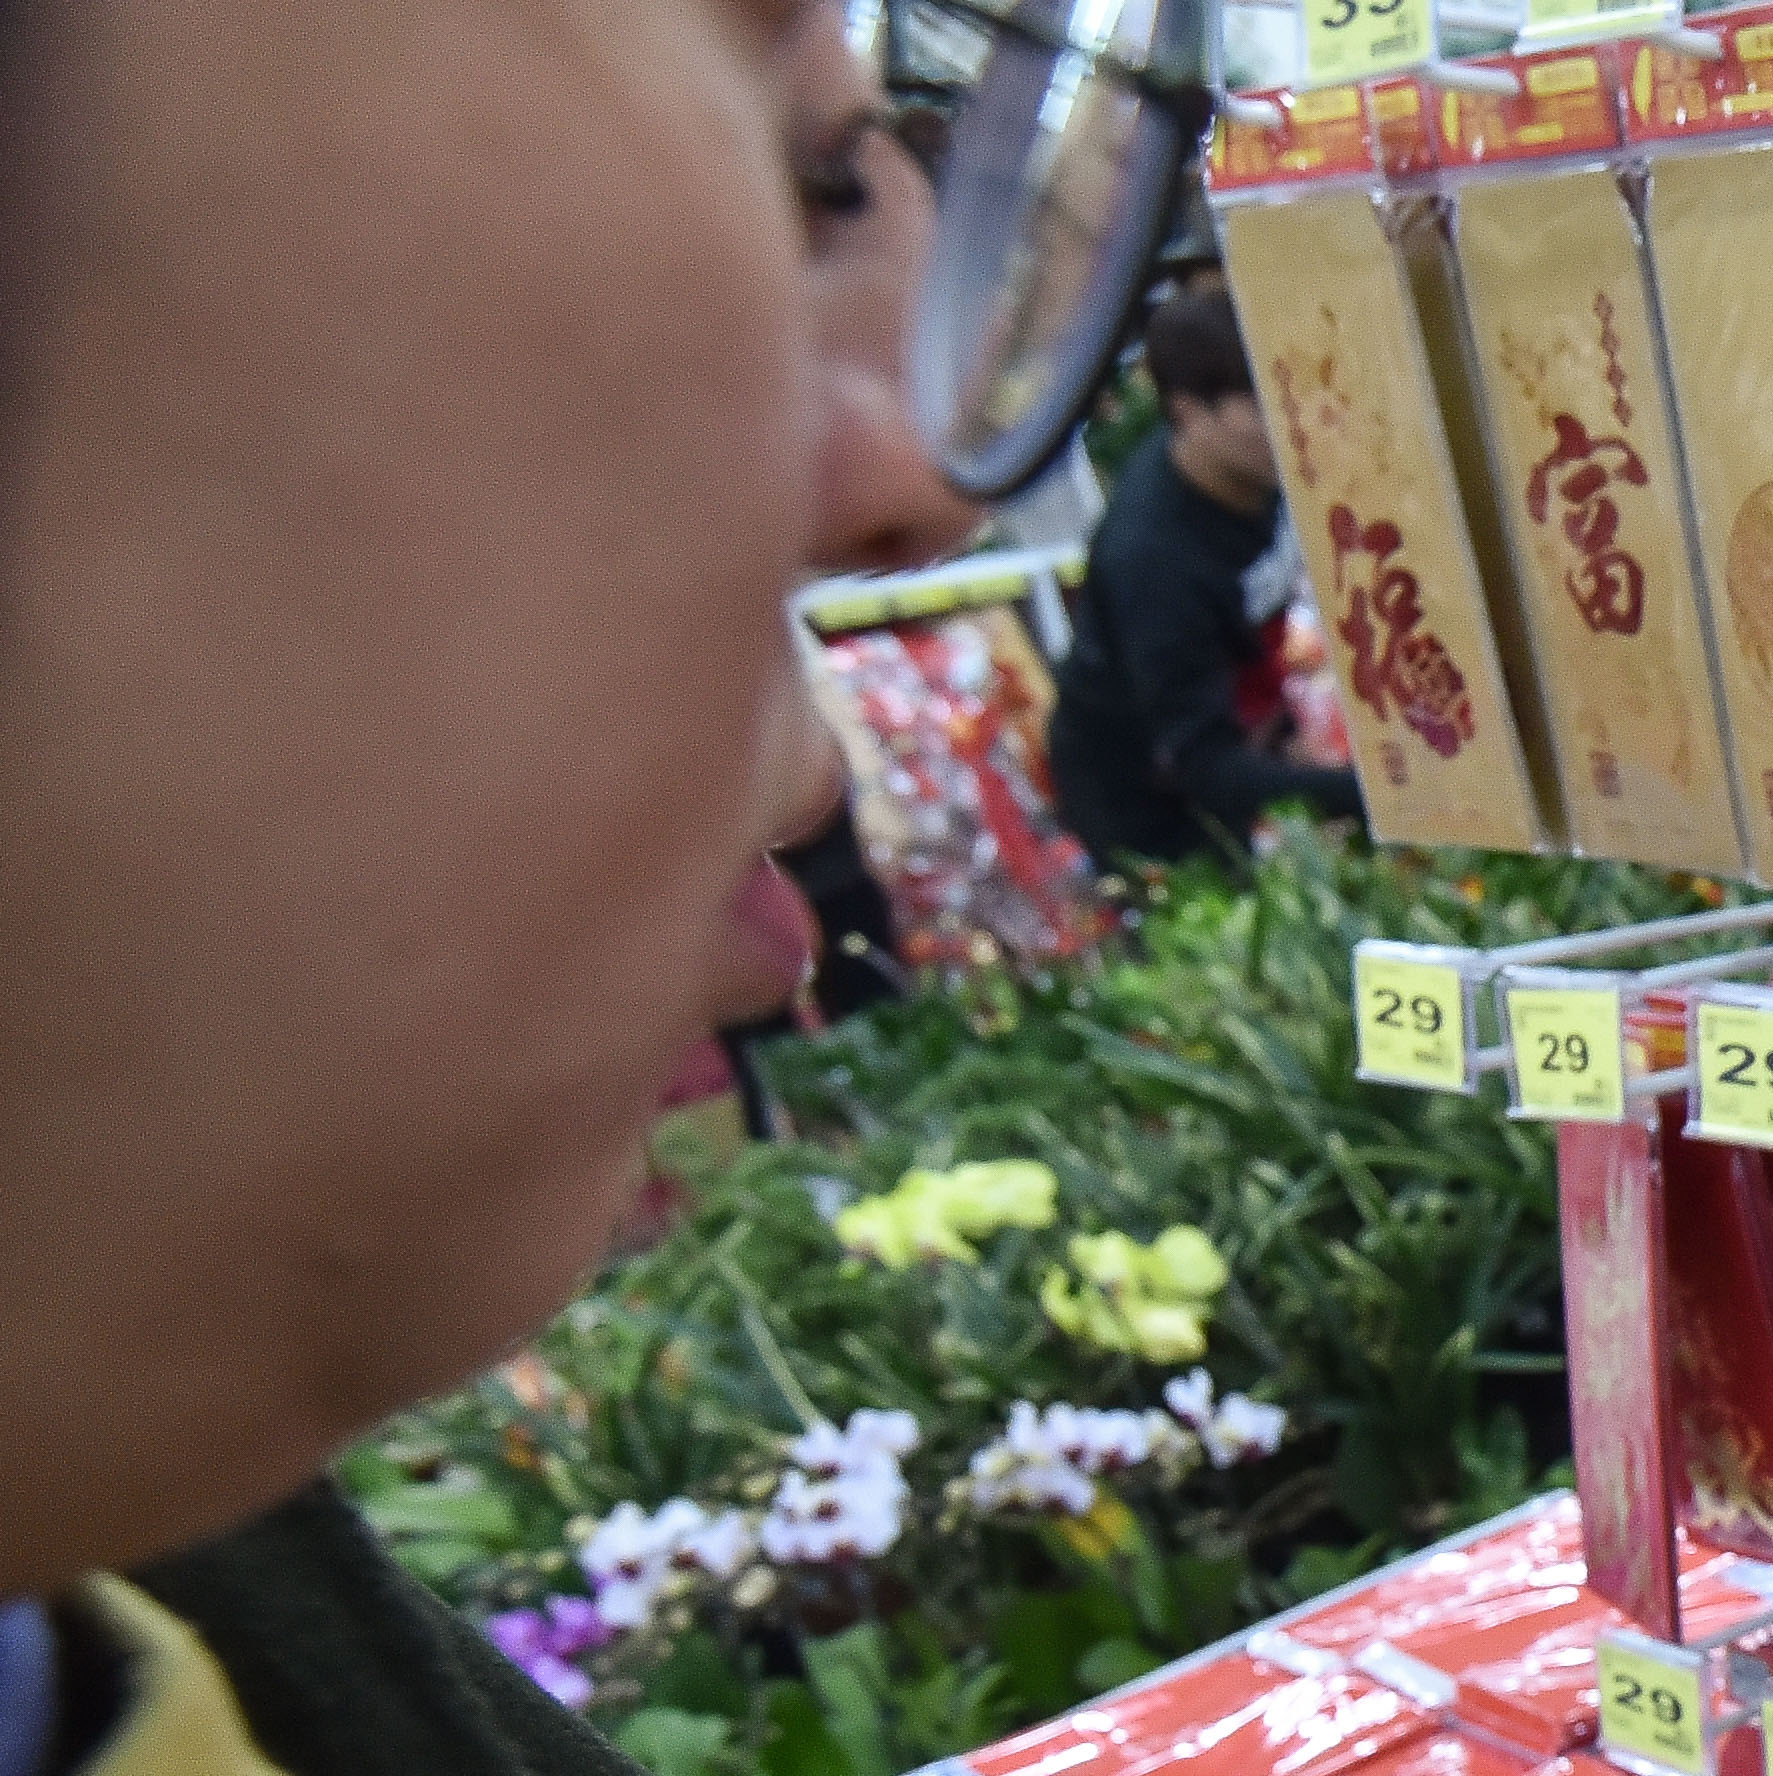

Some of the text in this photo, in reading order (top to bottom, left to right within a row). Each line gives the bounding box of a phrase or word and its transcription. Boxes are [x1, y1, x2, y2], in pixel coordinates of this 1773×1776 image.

[1525, 412, 1650, 635] 富
[1325, 503, 1422, 725] 福
[1373, 988, 1443, 1035] 29
[1538, 1032, 1591, 1074] 29
[1612, 1675, 1684, 1726] 29
